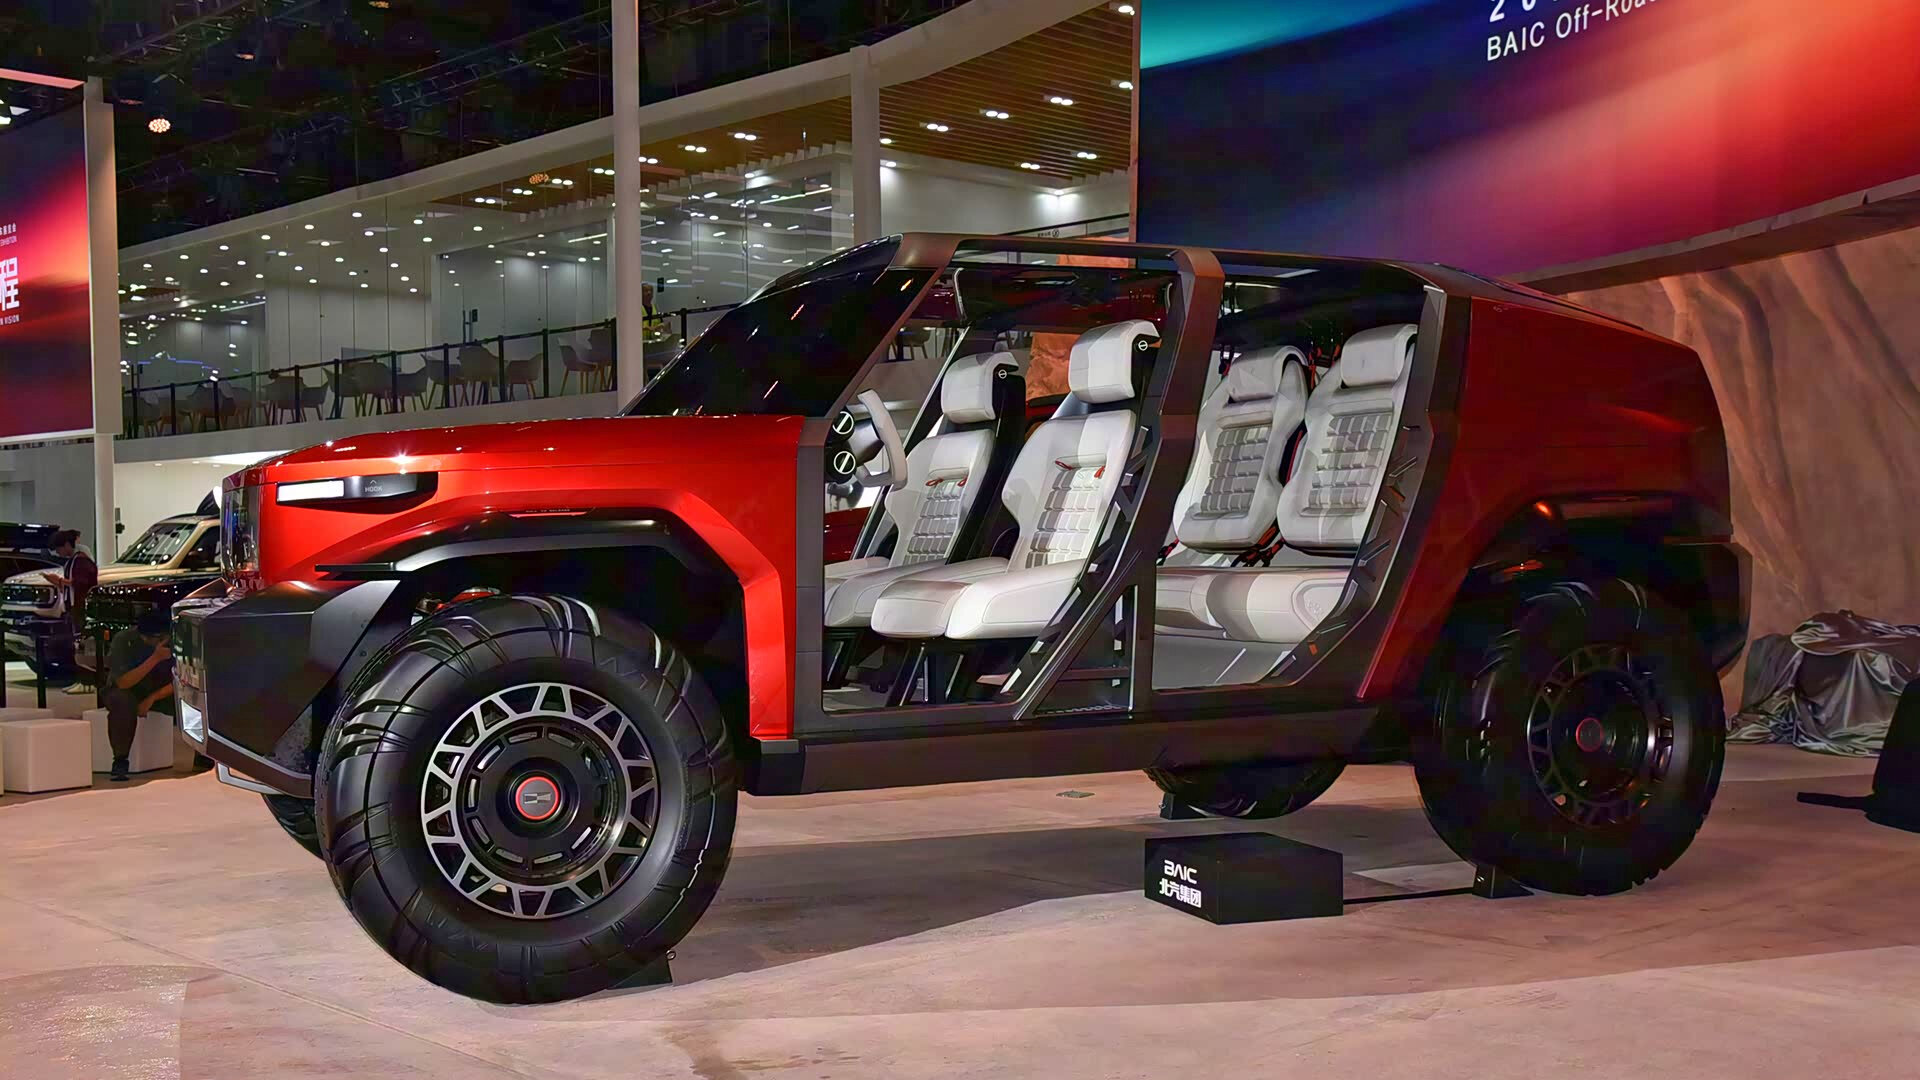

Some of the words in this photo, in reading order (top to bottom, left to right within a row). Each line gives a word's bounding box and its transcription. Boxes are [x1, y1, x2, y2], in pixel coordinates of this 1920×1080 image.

[1487, 21, 1545, 61] BAIC
[1164, 860, 1197, 884] BAIC
[1159, 878, 1202, 908] 北汽集团
